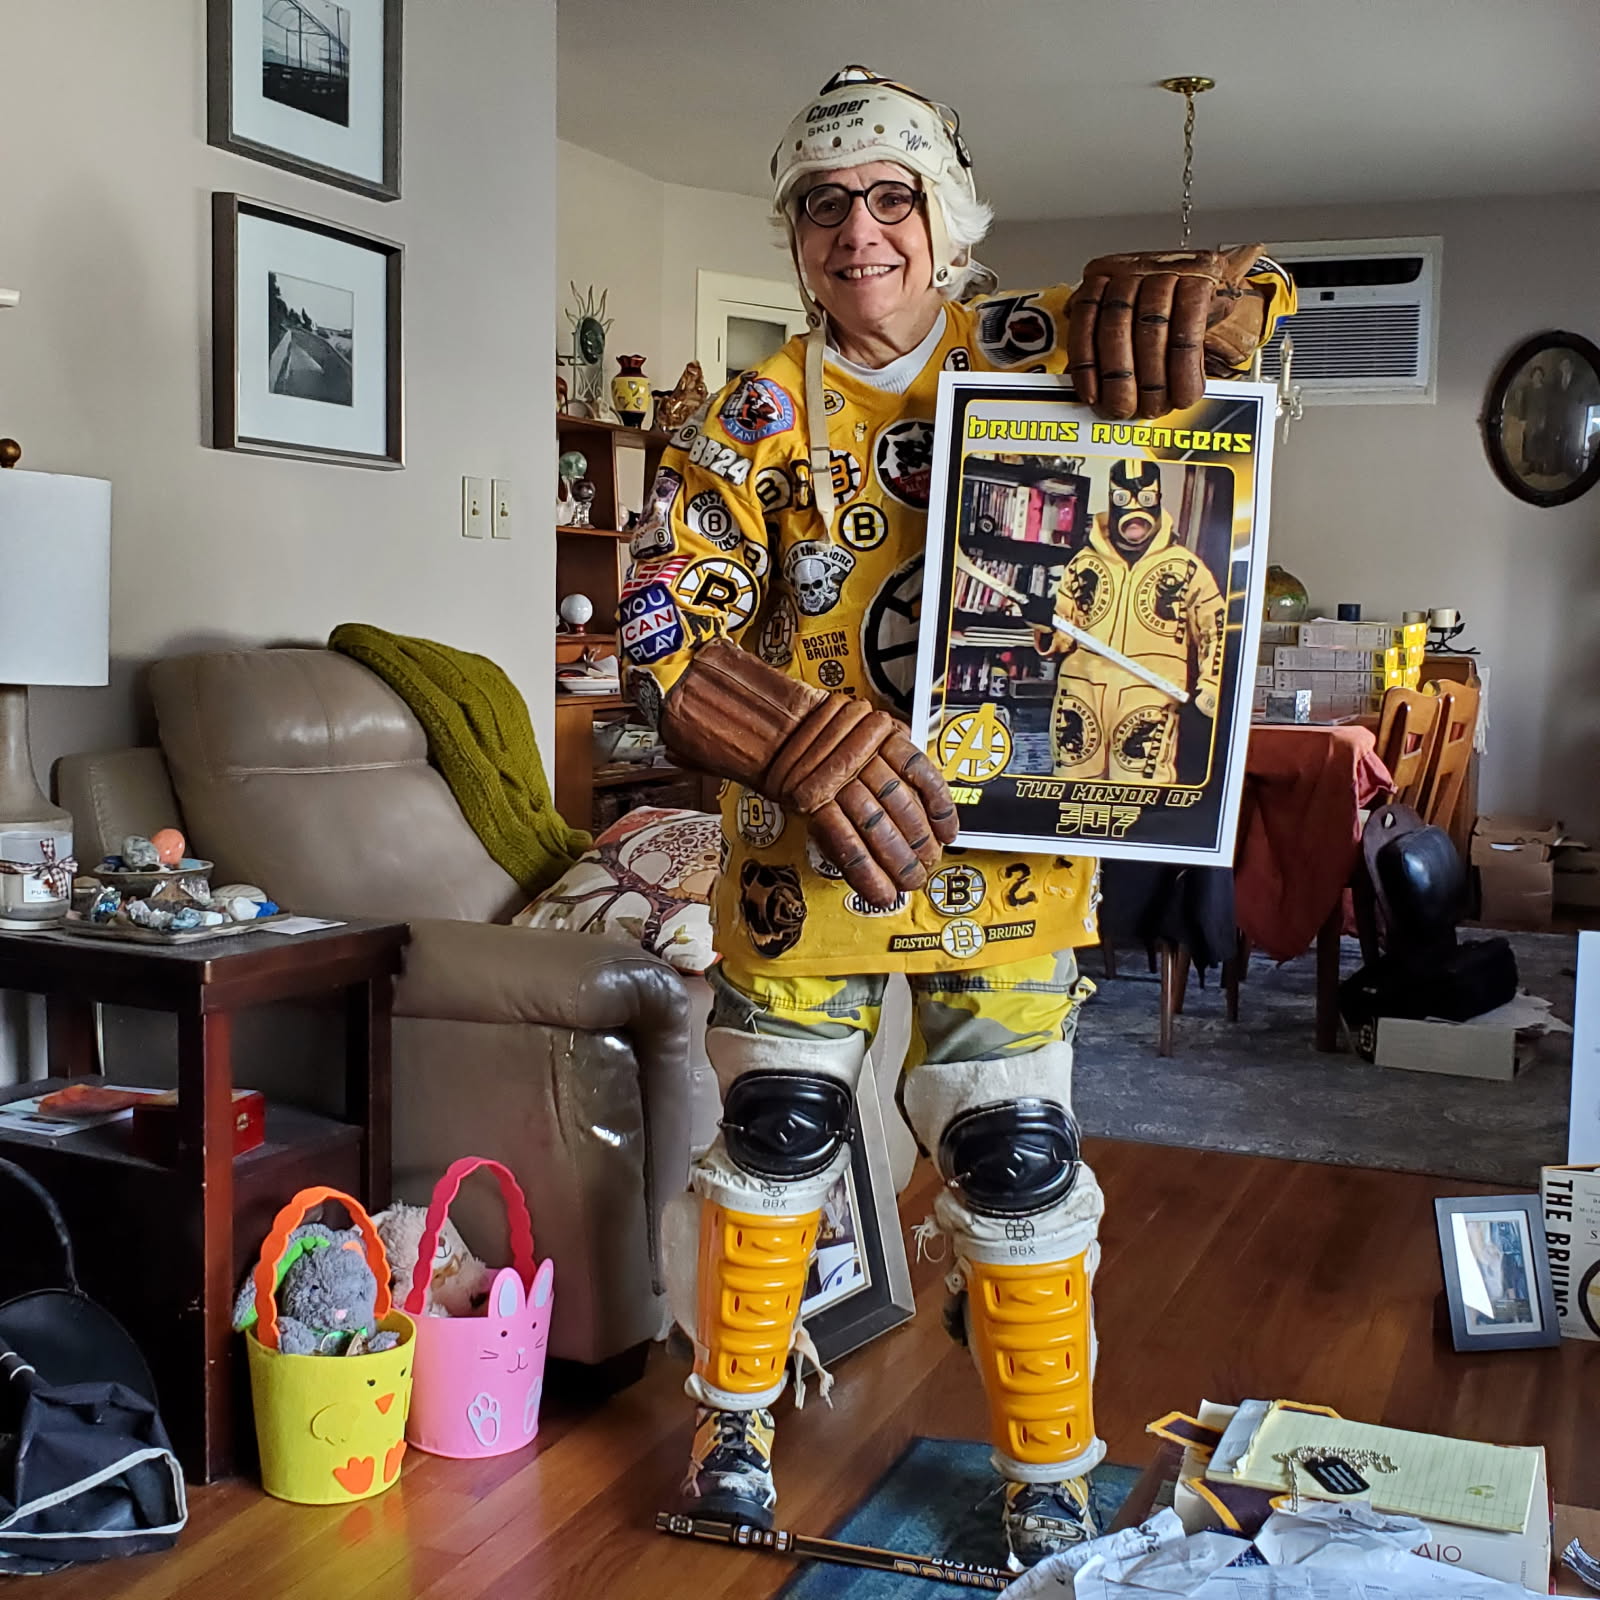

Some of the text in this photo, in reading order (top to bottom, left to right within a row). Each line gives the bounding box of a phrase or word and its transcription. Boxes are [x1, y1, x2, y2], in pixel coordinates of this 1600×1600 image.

[806, 99, 870, 123] Cooper
[807, 117, 865, 137] SK10 JR
[824, 395, 836, 410] B
[1092, 423, 1252, 453] AVENGERS
[689, 435, 752, 486] BB24
[830, 459, 849, 494] B
[709, 513, 721, 531] B
[853, 512, 876, 541] B
[624, 588, 666, 619] YOU
[625, 609, 673, 641] CAN
[630, 629, 677, 662] PLAY
[802, 631, 847, 649] BOSTON
[805, 644, 849, 661] BRUINS
[1016, 781, 1202, 807] THE MAYOR OF
[1056, 802, 1141, 837] 307
[945, 875, 972, 907] B
[1005, 863, 1037, 907] 2
[893, 923, 1033, 951] BOSTON B BRUINS
[762, 1198, 787, 1209] BBX
[1546, 1180, 1573, 1222] THE
[1010, 1245, 1036, 1256] BBX
